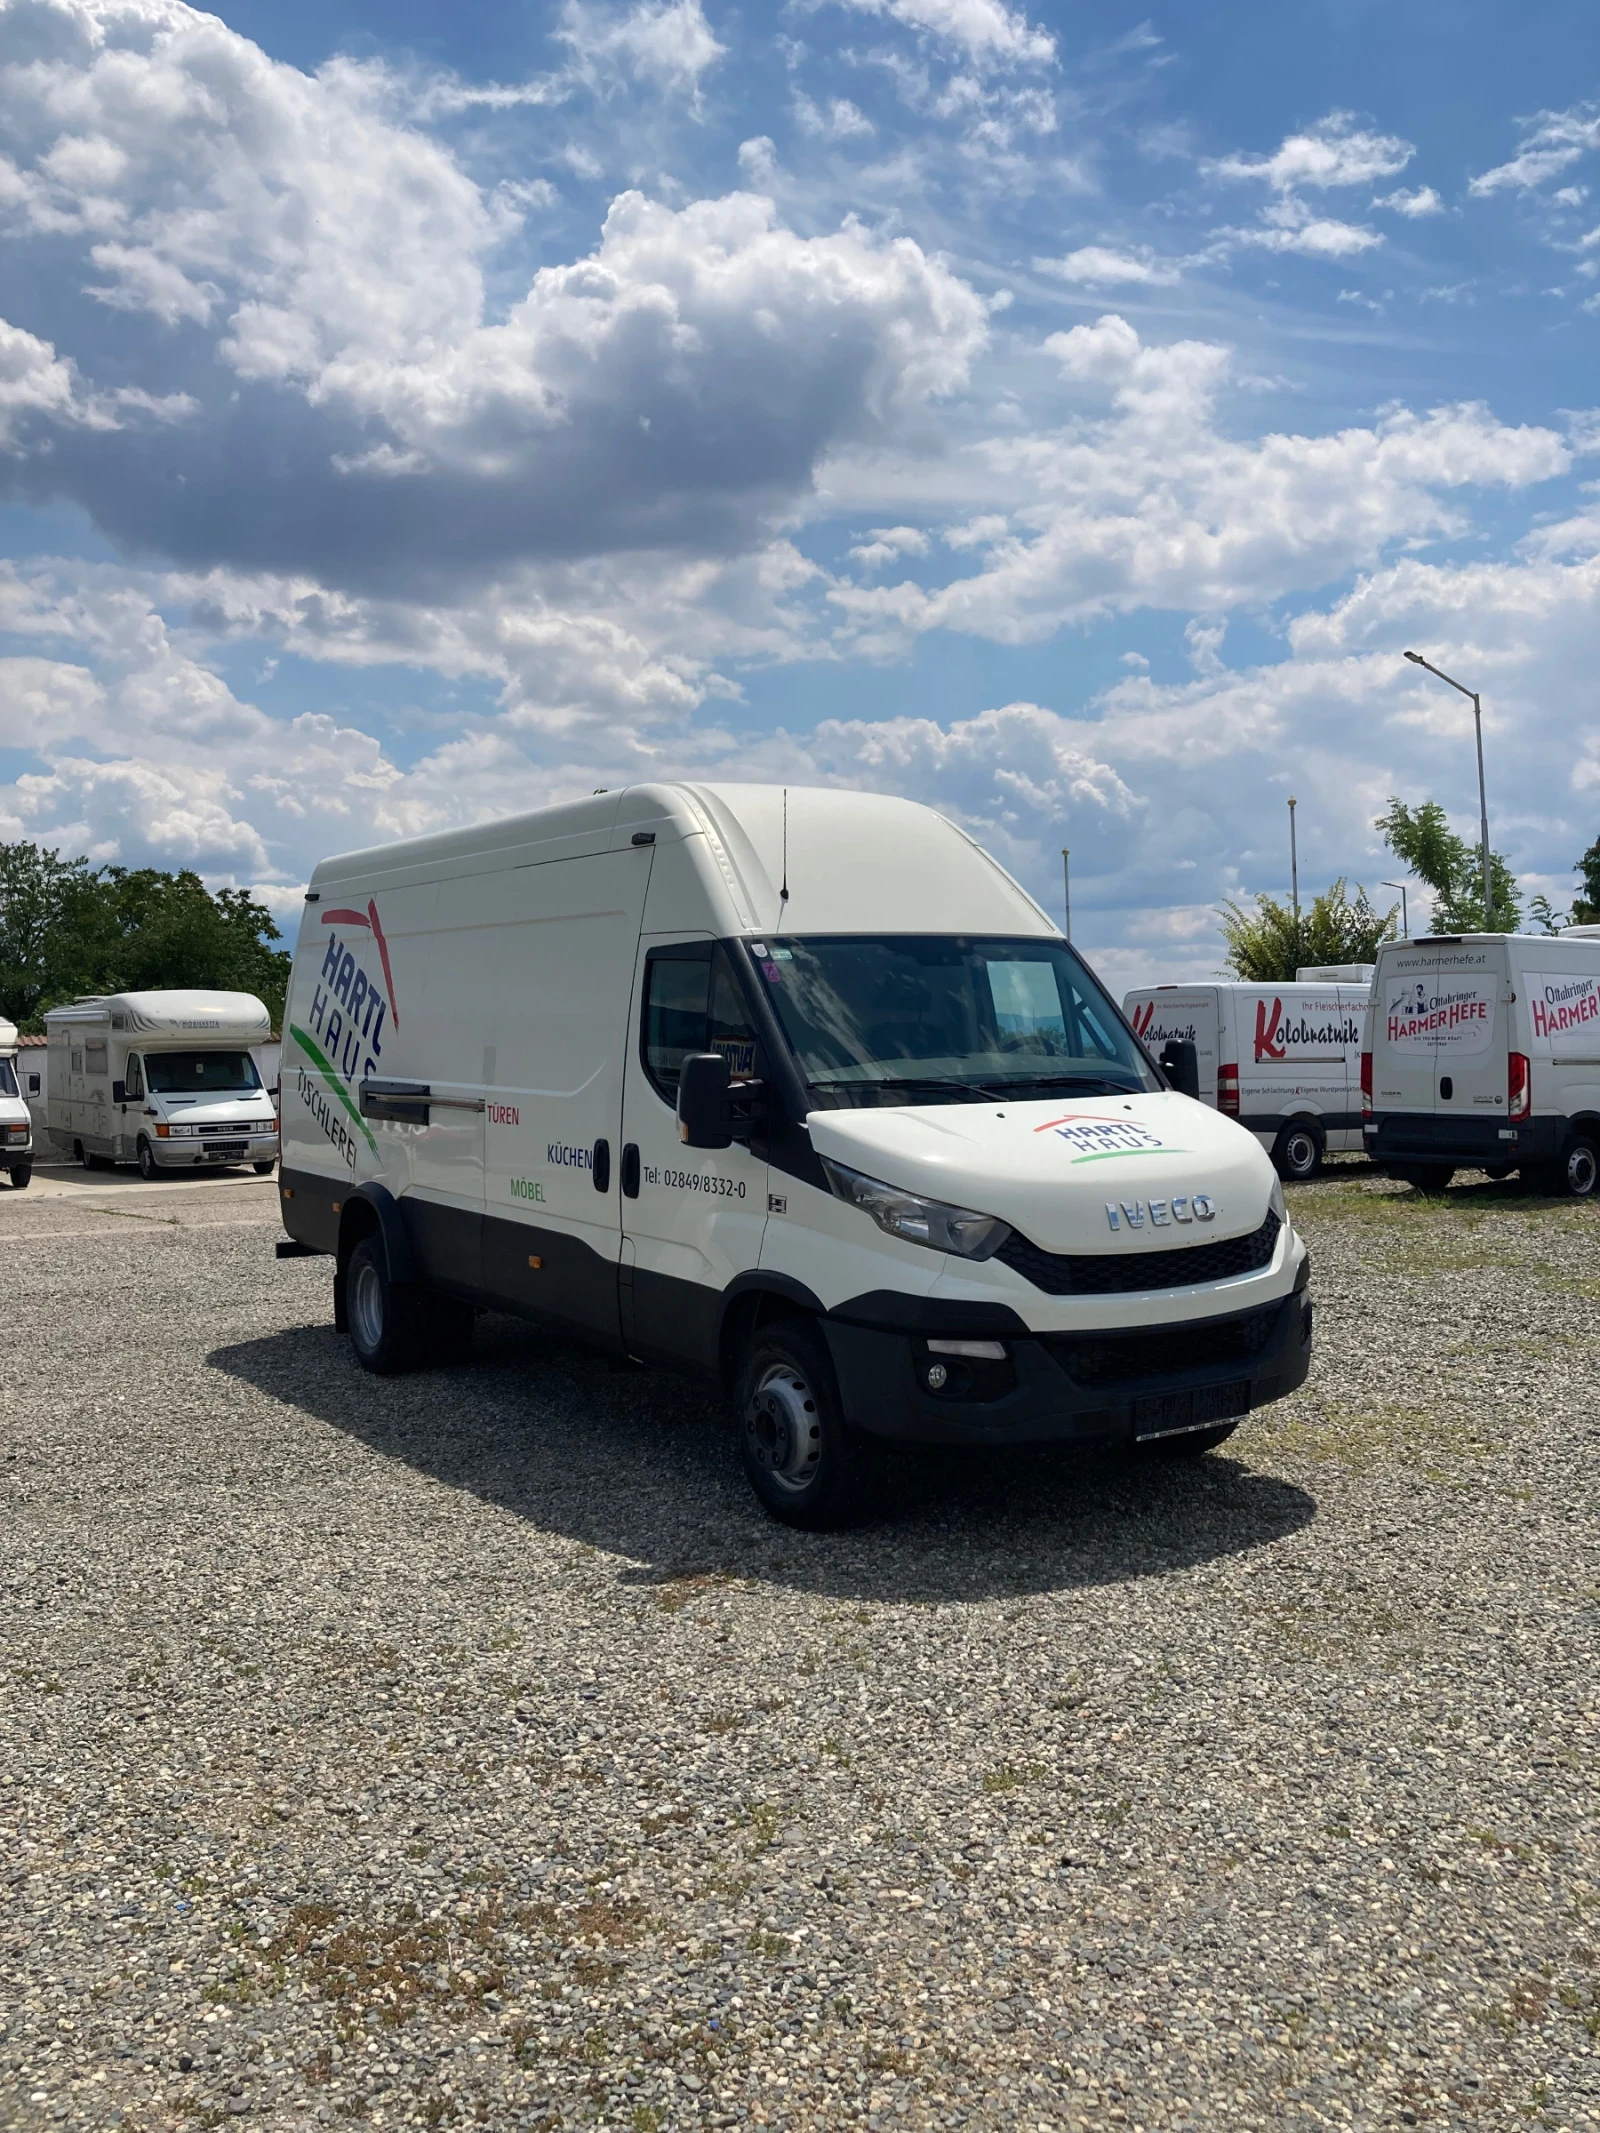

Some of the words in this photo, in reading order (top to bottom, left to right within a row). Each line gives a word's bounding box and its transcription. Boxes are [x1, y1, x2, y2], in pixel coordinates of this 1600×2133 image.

[1397, 954, 1485, 967] www.harmerhefe.at
[322, 932, 386, 1056] HARTL
[1429, 991, 1477, 1010] Ottakringer
[1545, 979, 1593, 1004] Ottakringer
[1302, 1001, 1313, 1011] Ihr
[1253, 996, 1359, 1058] Kolobratnik
[1241, 1087, 1260, 1096] Eigene
[1261, 1087, 1295, 1095] Schlachtung
[1301, 1087, 1319, 1095] Eigene
[1319, 1086, 1362, 1094] Wurstproduktio
[297, 1066, 357, 1171] TISCHLEREI
[487, 1102, 519, 1125] TÜREN
[1054, 1123, 1147, 1139] HARTL
[1071, 1134, 1163, 1152] HAUS
[547, 1141, 593, 1170] KÜCHEN
[510, 1176, 546, 1203] MÖBEL
[644, 1167, 661, 1185] Tel:
[664, 1170, 746, 1199] 02849/8332-0
[1105, 1194, 1216, 1231] IVECO
